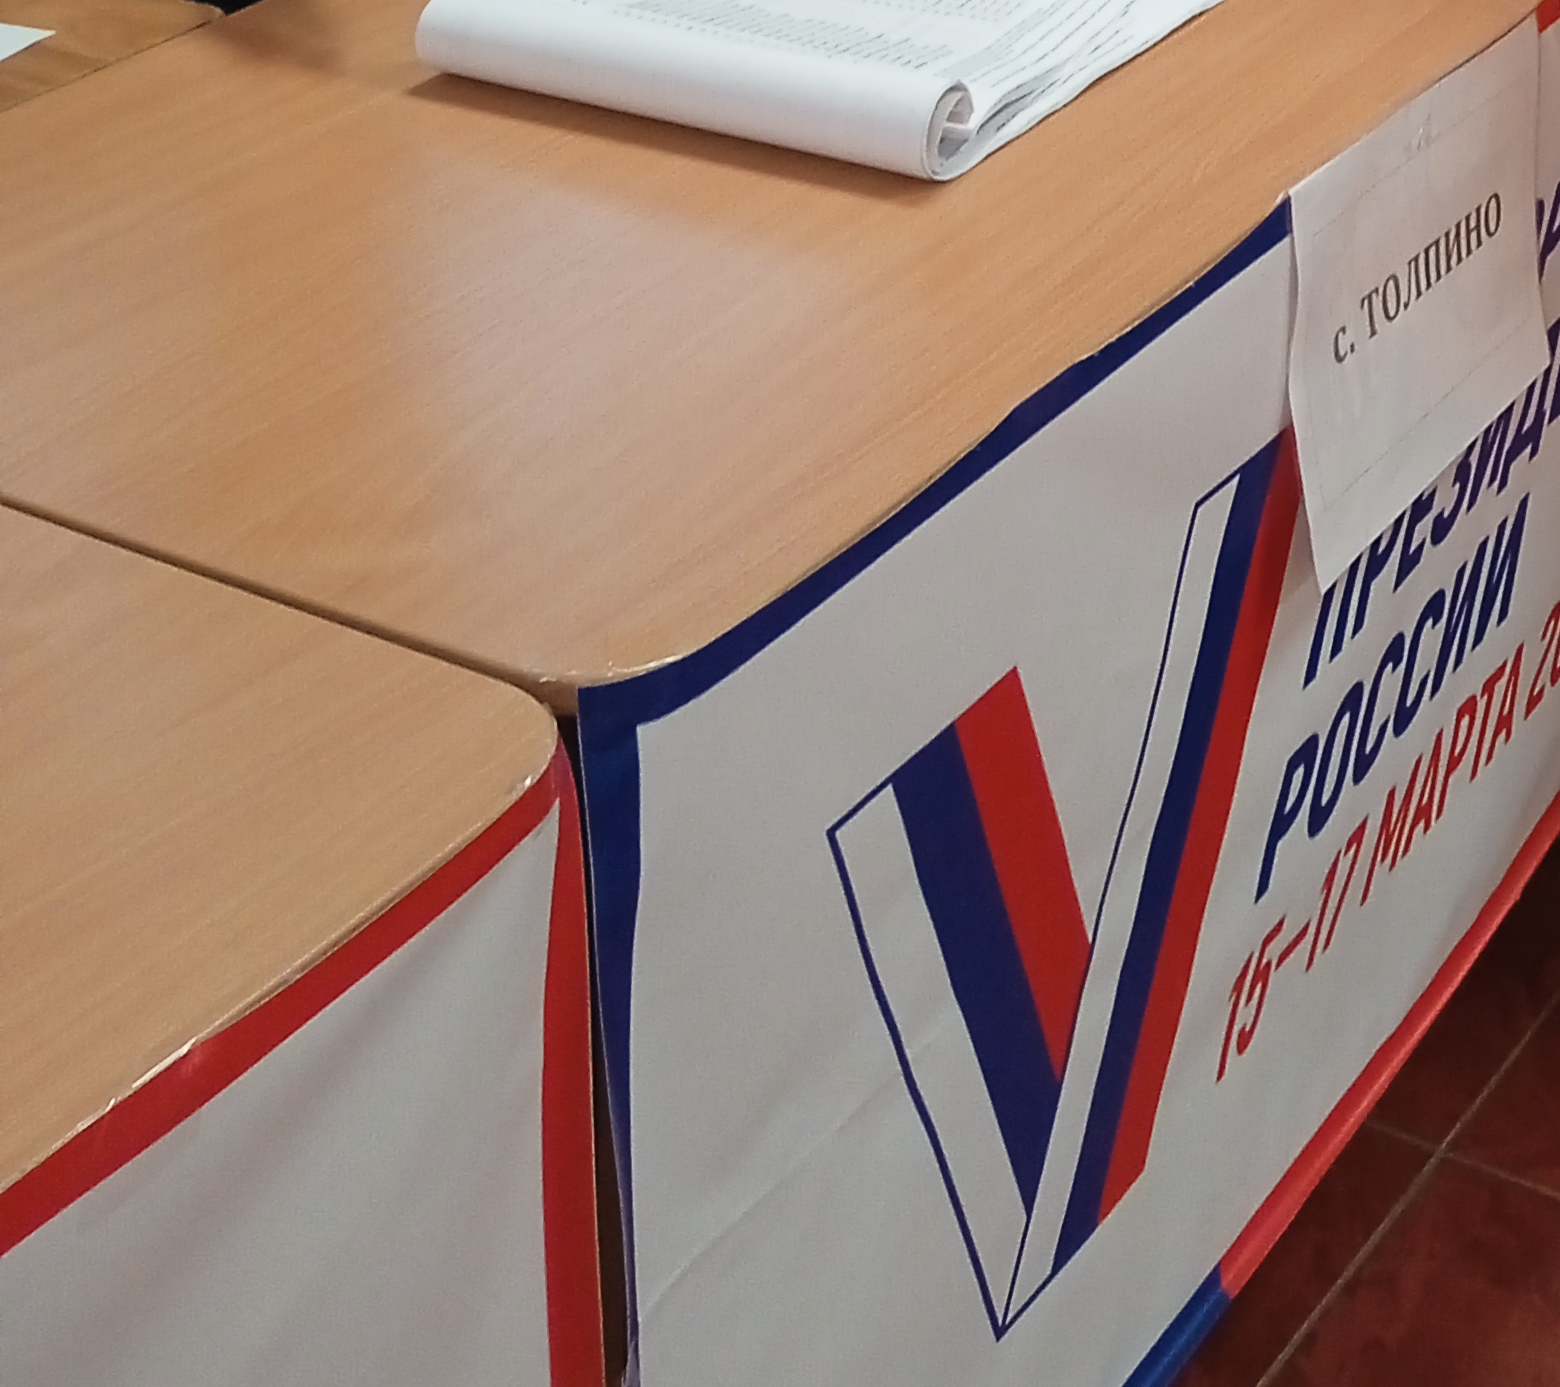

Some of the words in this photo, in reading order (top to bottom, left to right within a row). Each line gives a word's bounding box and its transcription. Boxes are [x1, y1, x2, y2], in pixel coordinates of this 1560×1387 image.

[1332, 325, 1355, 364] с.
[1360, 192, 1502, 340] ТОЛПИНО
[1254, 492, 1531, 905] РОССИИ
[1360, 641, 1525, 908] МАРТА
